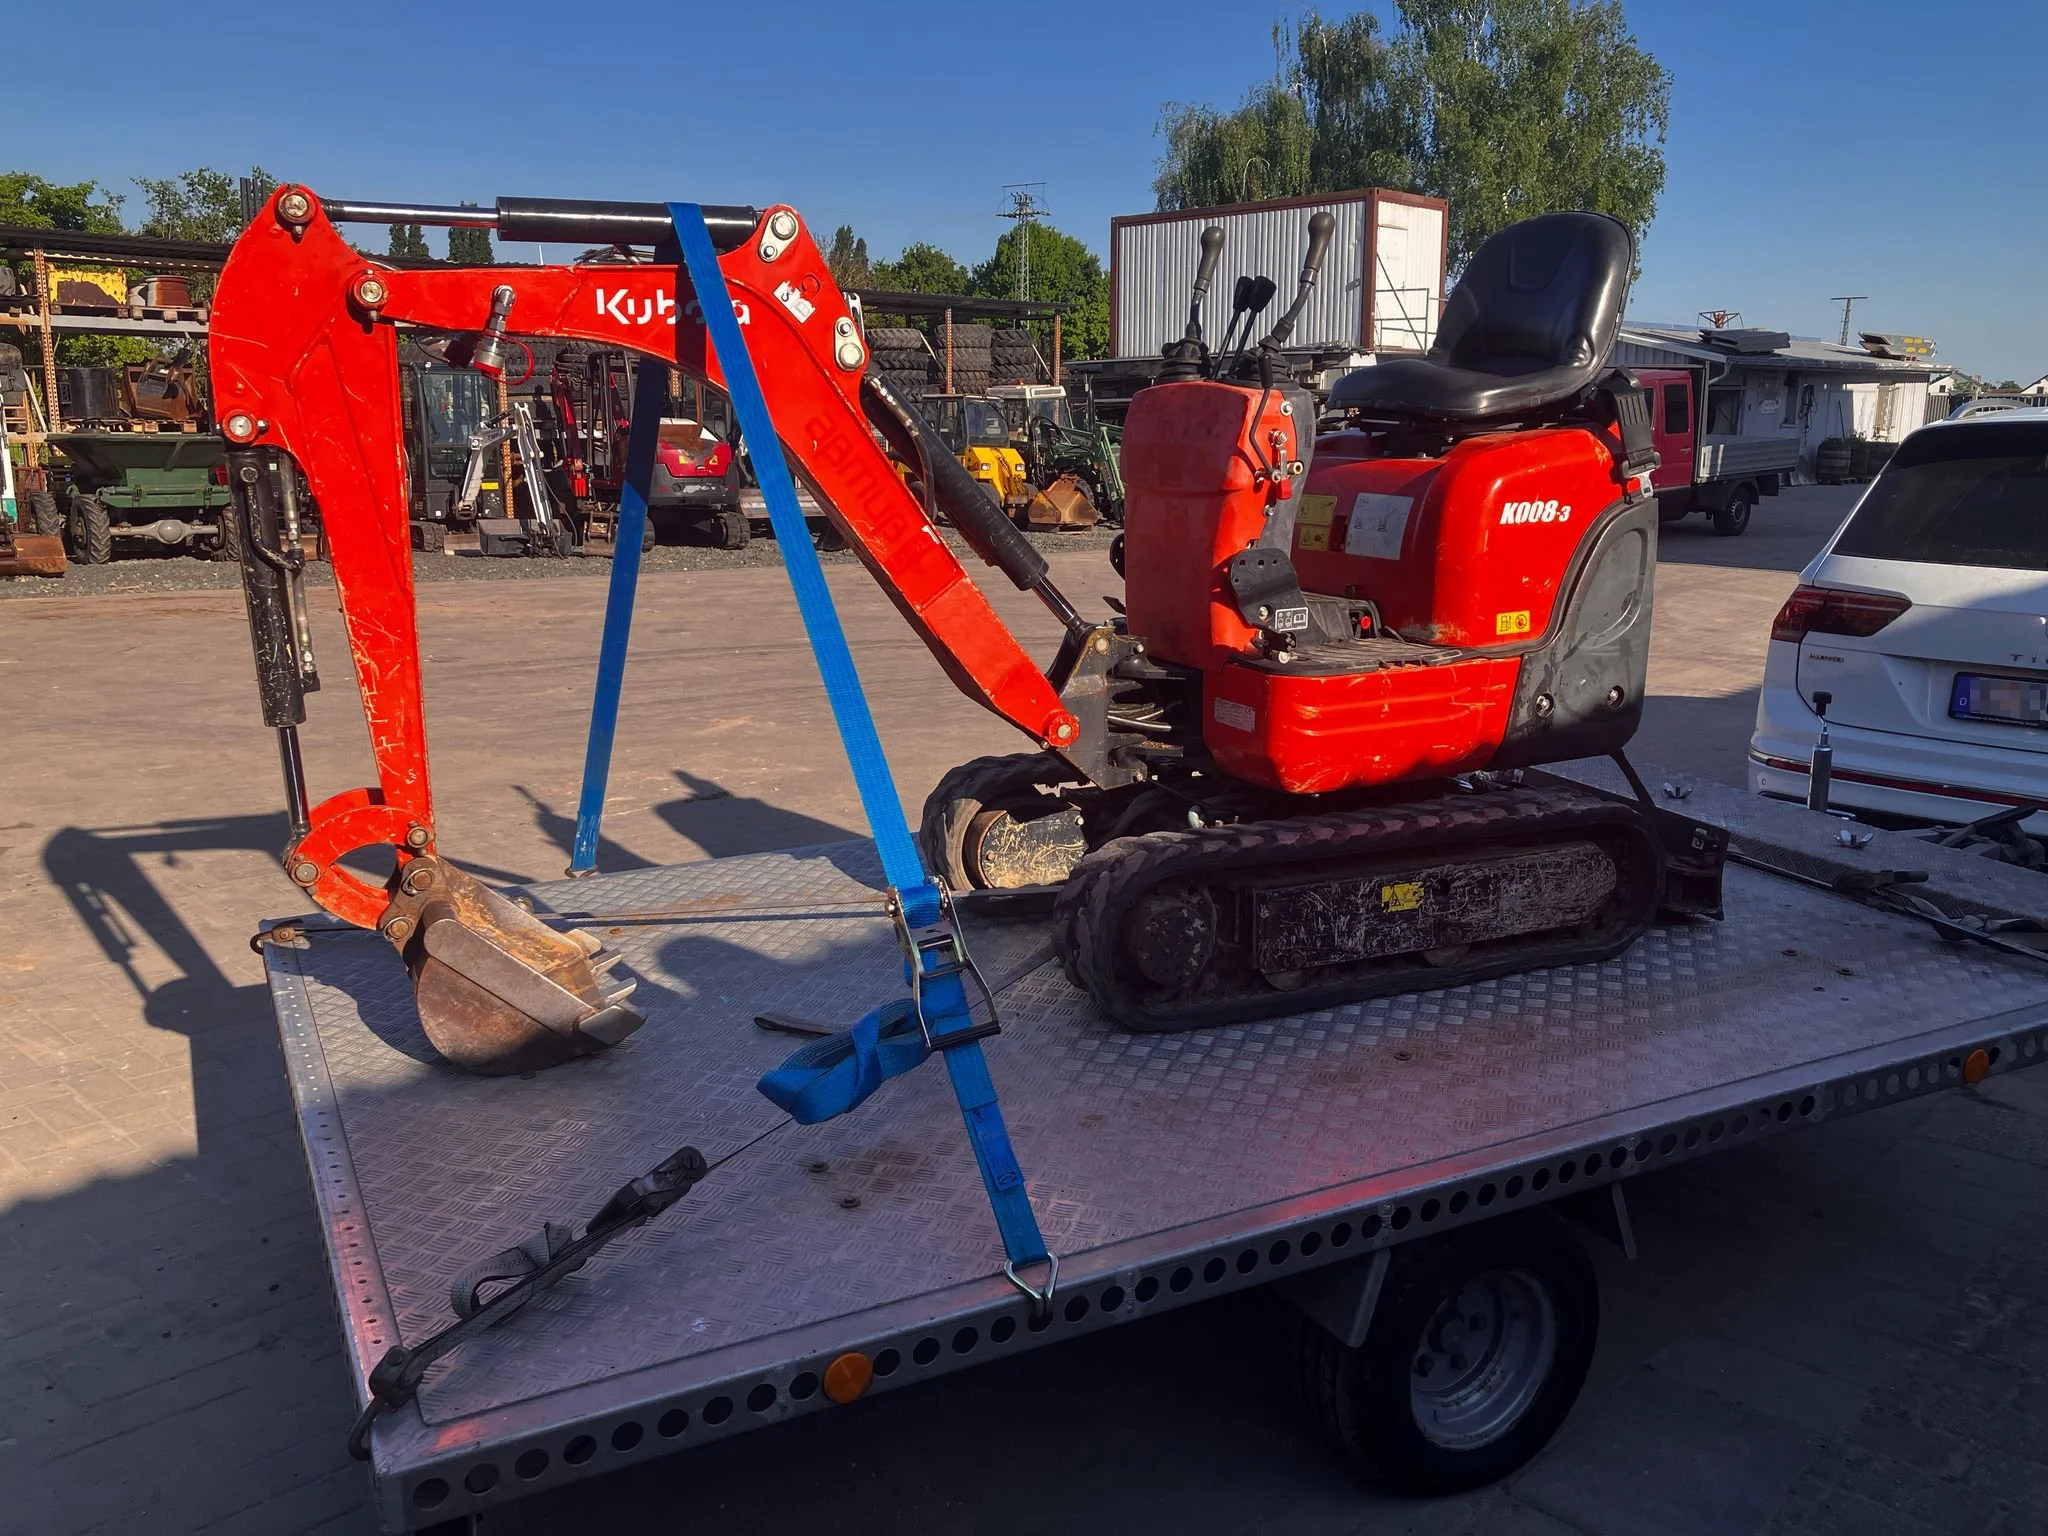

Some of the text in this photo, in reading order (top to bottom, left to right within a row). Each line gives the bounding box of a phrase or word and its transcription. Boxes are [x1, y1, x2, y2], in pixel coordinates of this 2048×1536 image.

[596, 288, 751, 325] Kuboa
[1500, 499, 1571, 525] K008-3
[1959, 696, 1968, 706] D
